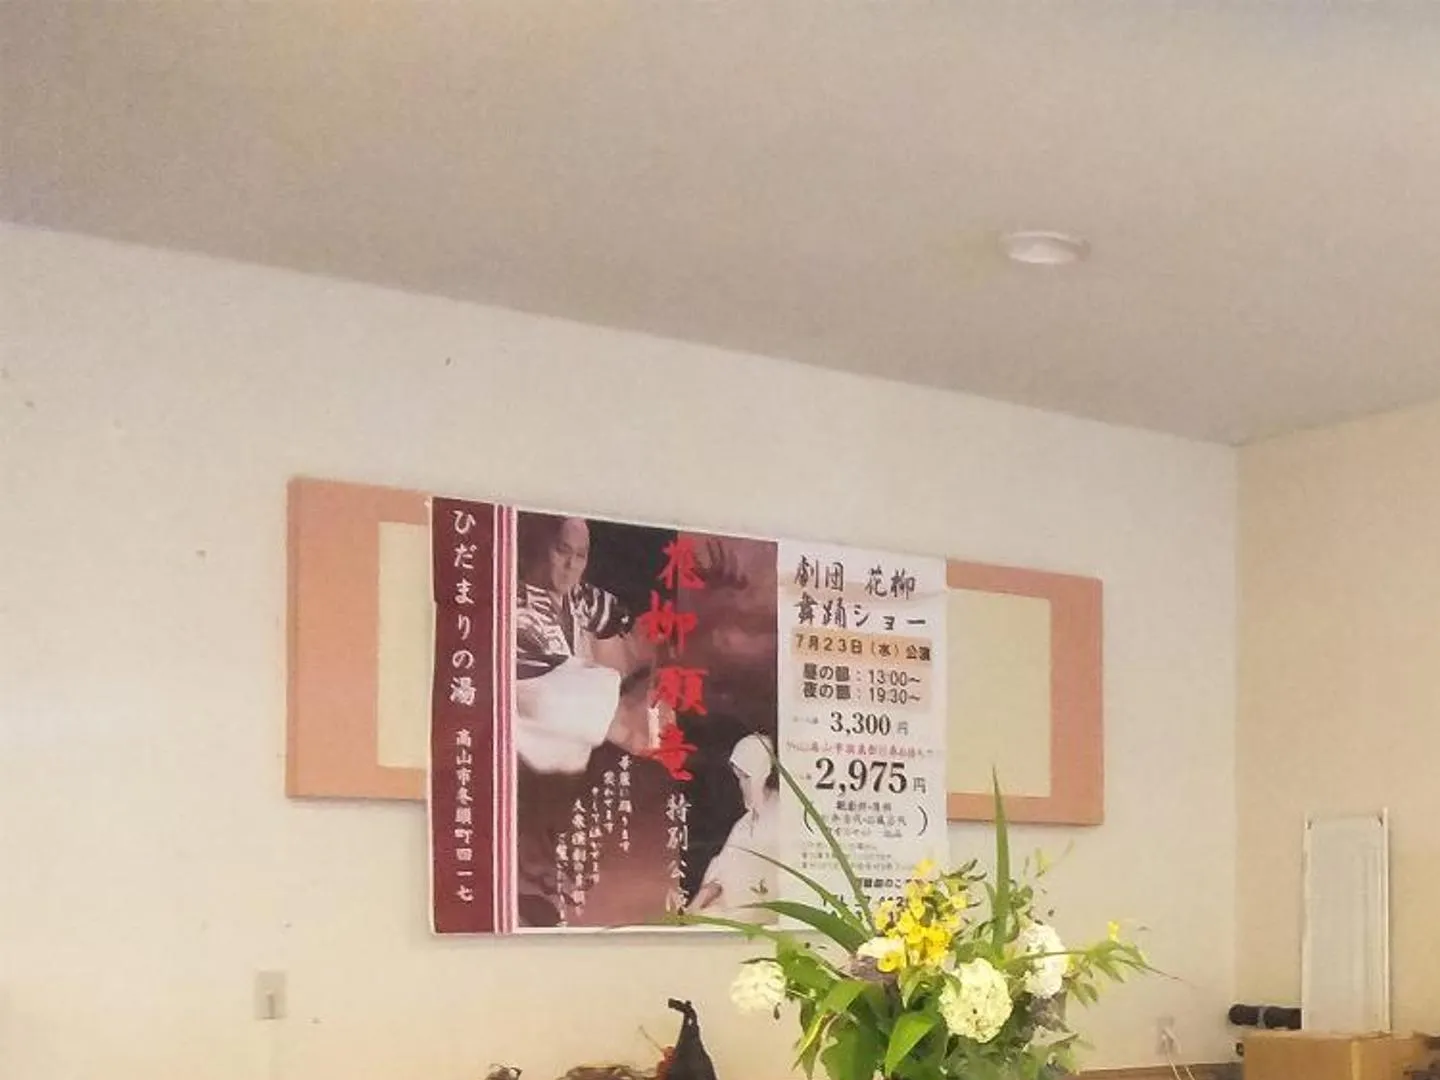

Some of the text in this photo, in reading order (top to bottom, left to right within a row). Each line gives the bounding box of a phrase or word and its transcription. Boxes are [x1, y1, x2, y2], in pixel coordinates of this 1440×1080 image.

[793, 554, 916, 601] 劇団 花柳
[449, 509, 478, 706] ひだまりの湯
[793, 592, 927, 630] 舞踊ショー
